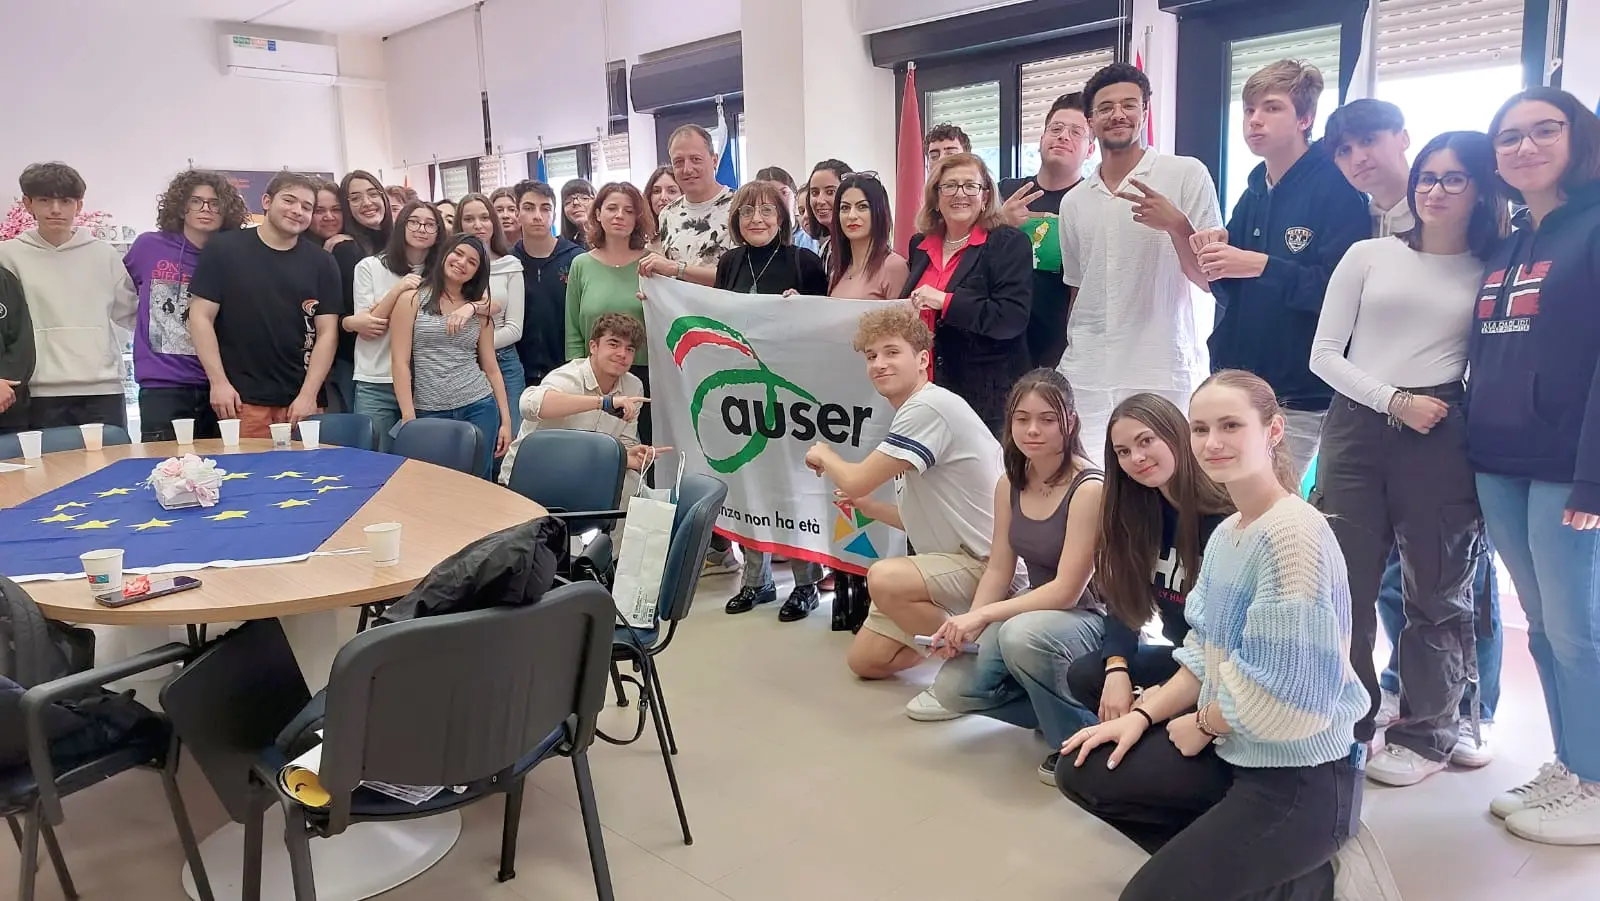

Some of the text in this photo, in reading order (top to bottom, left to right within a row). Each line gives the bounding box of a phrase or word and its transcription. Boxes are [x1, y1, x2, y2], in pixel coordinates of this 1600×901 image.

[721, 395, 873, 448] auser
[718, 505, 820, 534] nza non ha età
